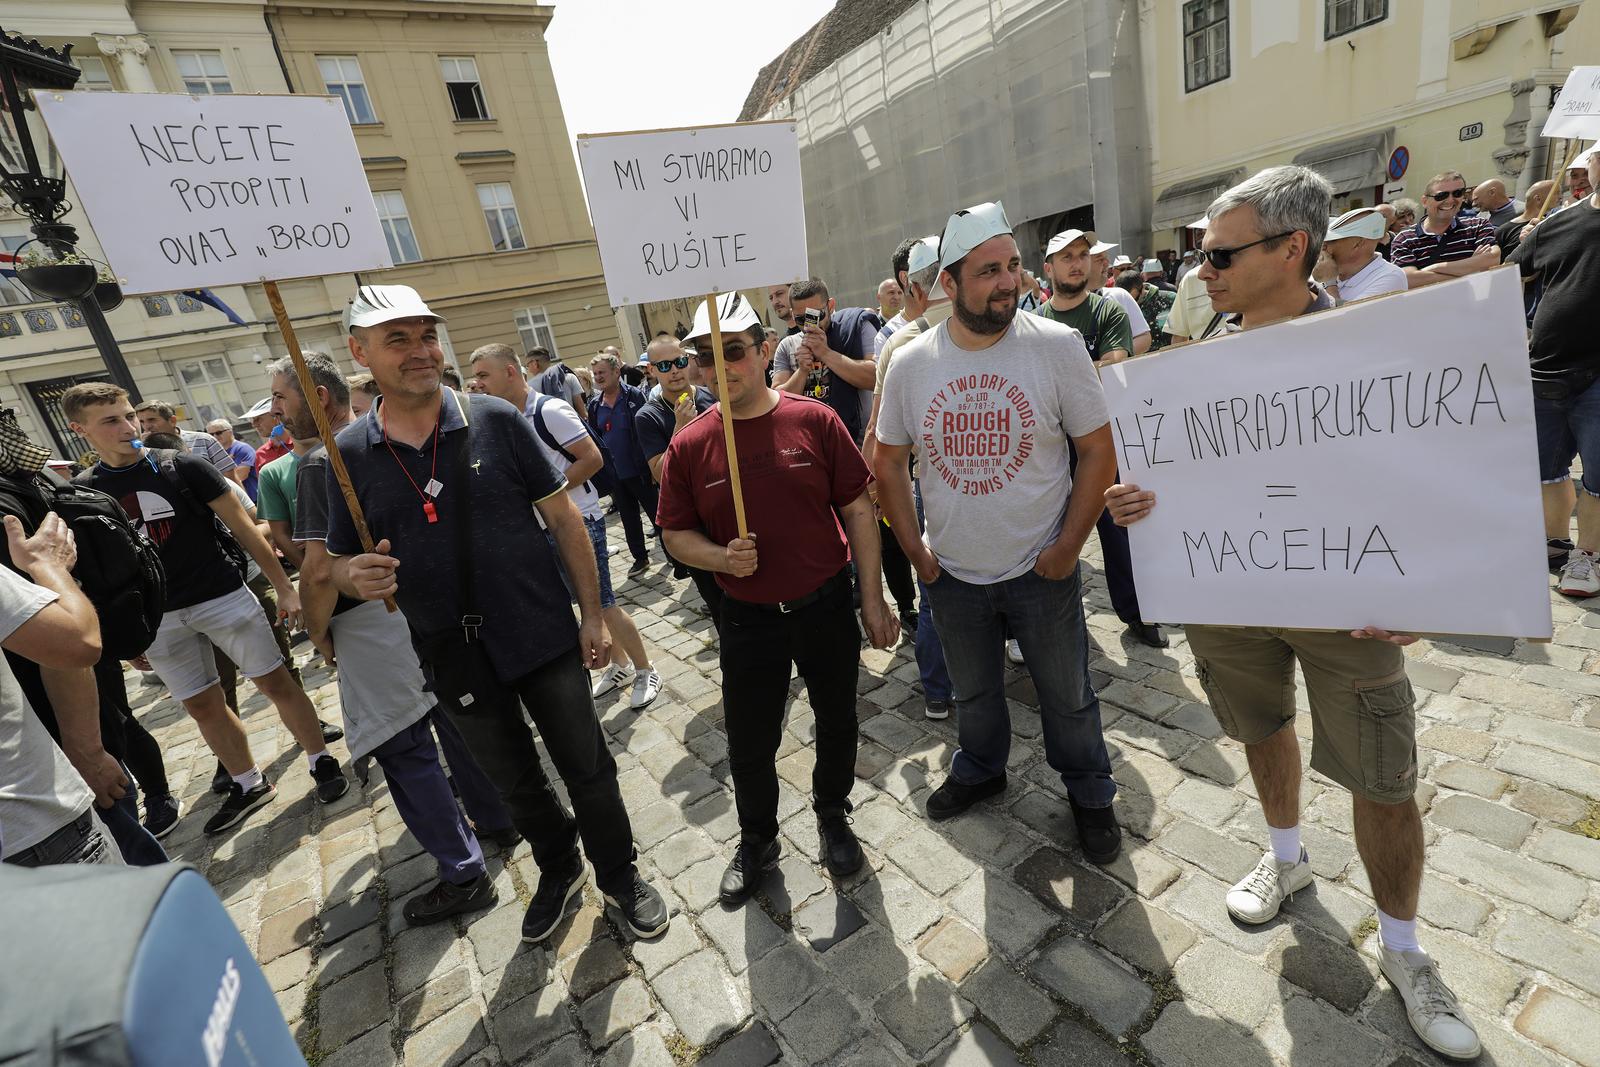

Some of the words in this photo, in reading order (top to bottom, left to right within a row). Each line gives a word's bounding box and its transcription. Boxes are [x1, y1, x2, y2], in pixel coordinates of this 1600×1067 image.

[129, 113, 295, 167] NEĆETE
[1465, 125, 1478, 136] 10
[613, 158, 646, 191] MI
[663, 147, 772, 183] STVARAMO
[170, 177, 309, 213] POTOPITI
[674, 192, 699, 222] VI
[159, 231, 237, 266] OVAJ
[641, 231, 757, 276] RUŠITE
[946, 374, 978, 396] TWO
[979, 373, 1009, 393] DRY
[923, 389, 948, 430] SIXTY
[942, 407, 1011, 435] ROUGH
[1005, 384, 1037, 429] GOODS
[1115, 398, 1174, 471] HŽ
[1184, 362, 1507, 461] INFRASTRUKTURA
[922, 432, 961, 491] NINETEEN
[942, 432, 1010, 457] RUGGED
[1002, 432, 1034, 482] SUPPLY
[951, 458, 965, 468] TOM
[966, 458, 990, 468] TAILOR
[991, 458, 1002, 467] TM
[961, 475, 1004, 497] SINCE
[1181, 511, 1406, 578] MAĆEHA
